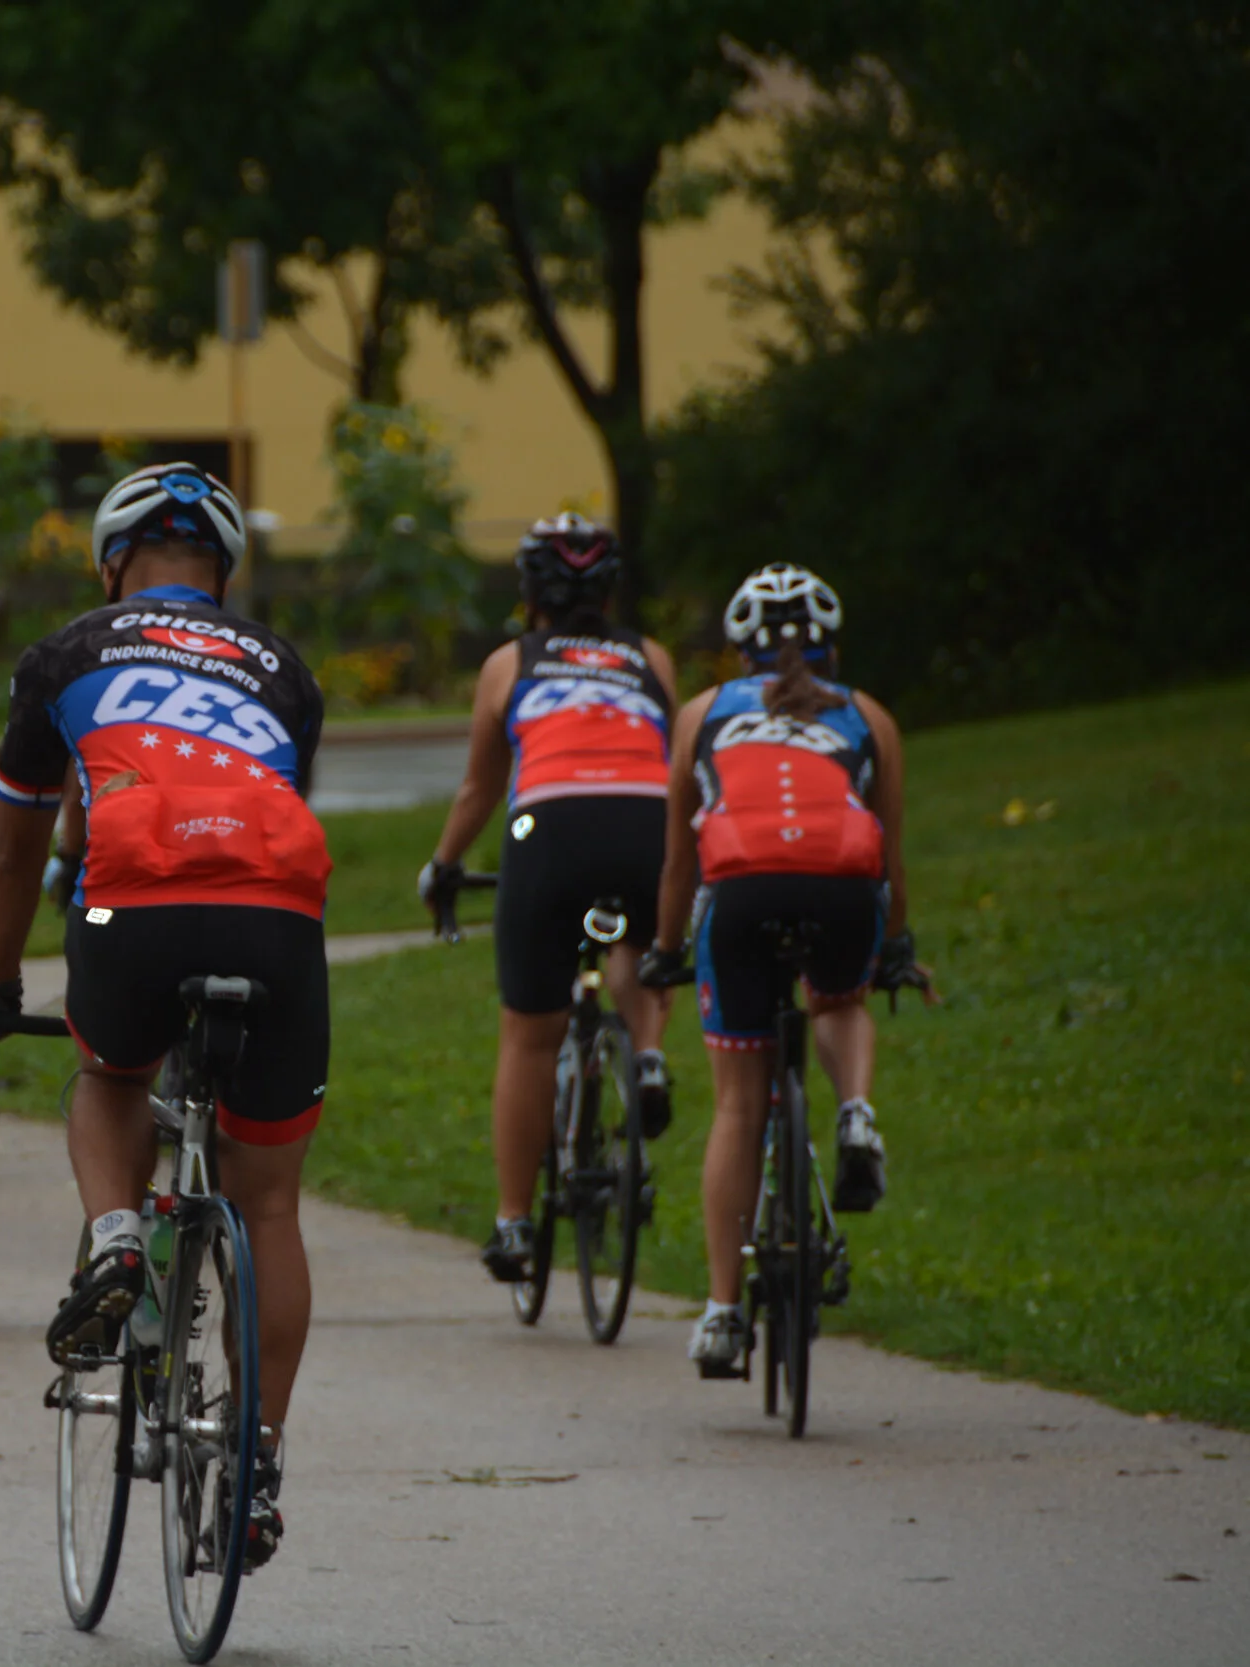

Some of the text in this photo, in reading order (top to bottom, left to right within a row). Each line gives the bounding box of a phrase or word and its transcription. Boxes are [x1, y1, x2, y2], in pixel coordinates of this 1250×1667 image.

[100, 645, 262, 693] ENDURANCE SPORTS
[111, 612, 280, 673] CHICAGO
[92, 667, 291, 756] CES
[712, 712, 851, 755] CES
